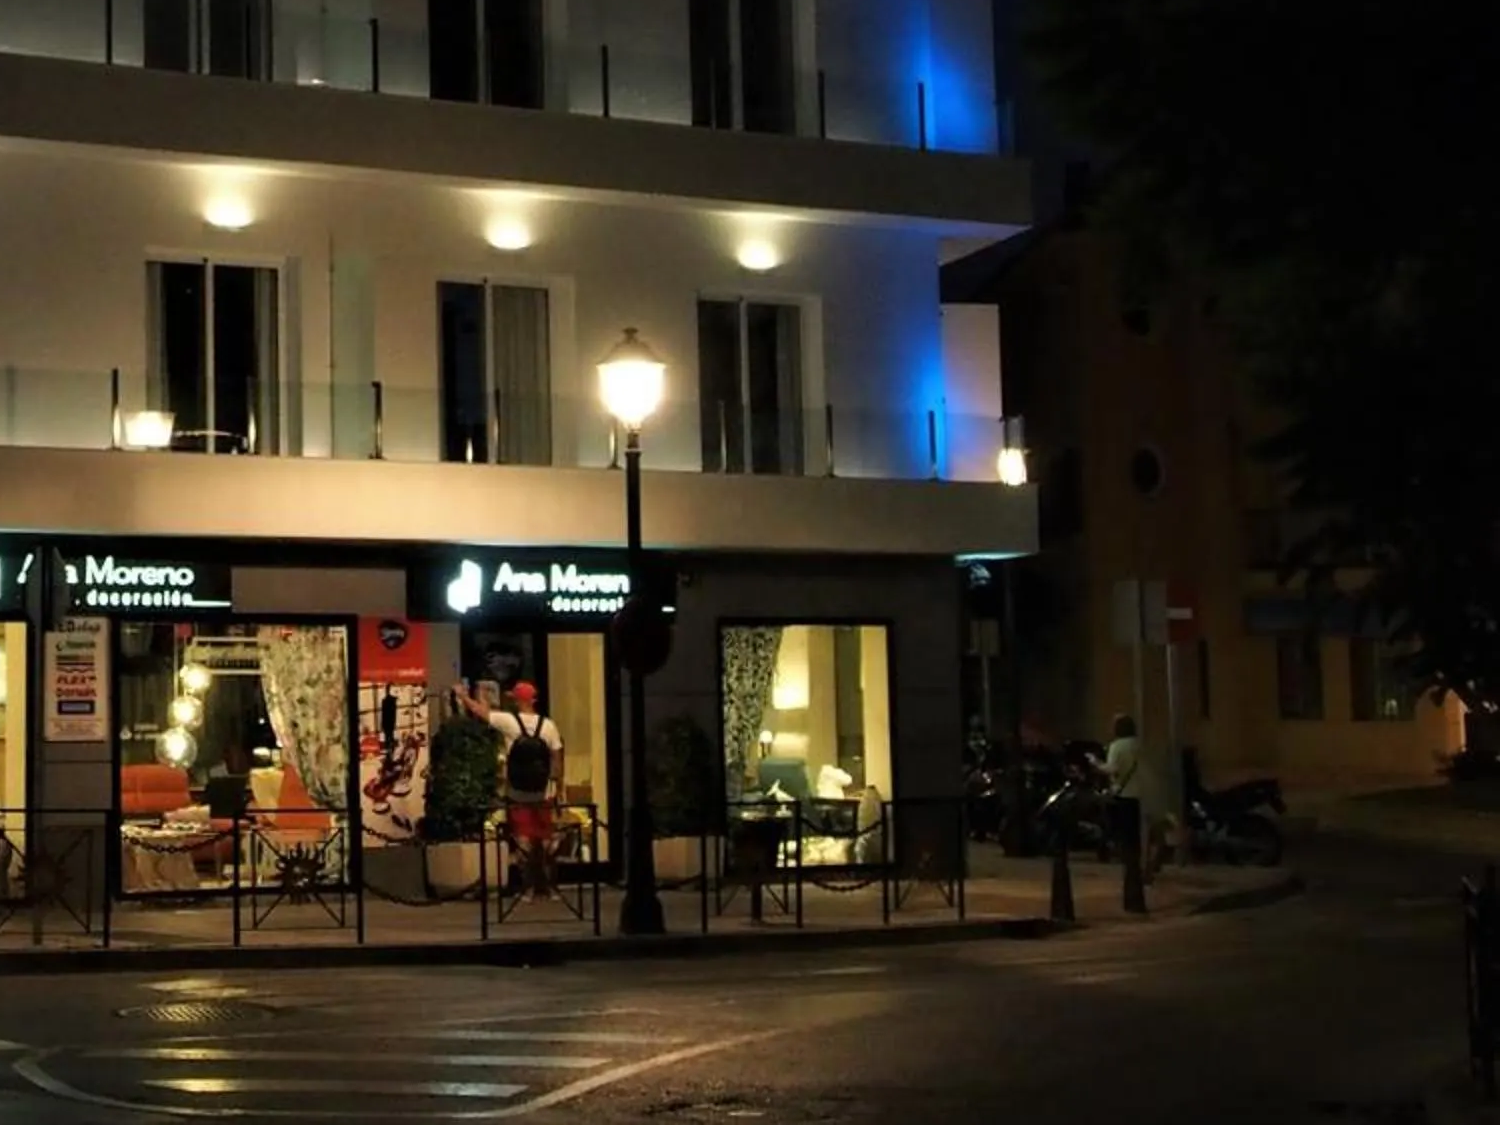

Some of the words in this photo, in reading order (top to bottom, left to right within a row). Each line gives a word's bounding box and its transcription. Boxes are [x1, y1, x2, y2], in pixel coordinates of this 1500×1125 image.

[85, 555, 195, 586] Moreno
[493, 562, 547, 592] Ana
[550, 564, 631, 593] Moren
